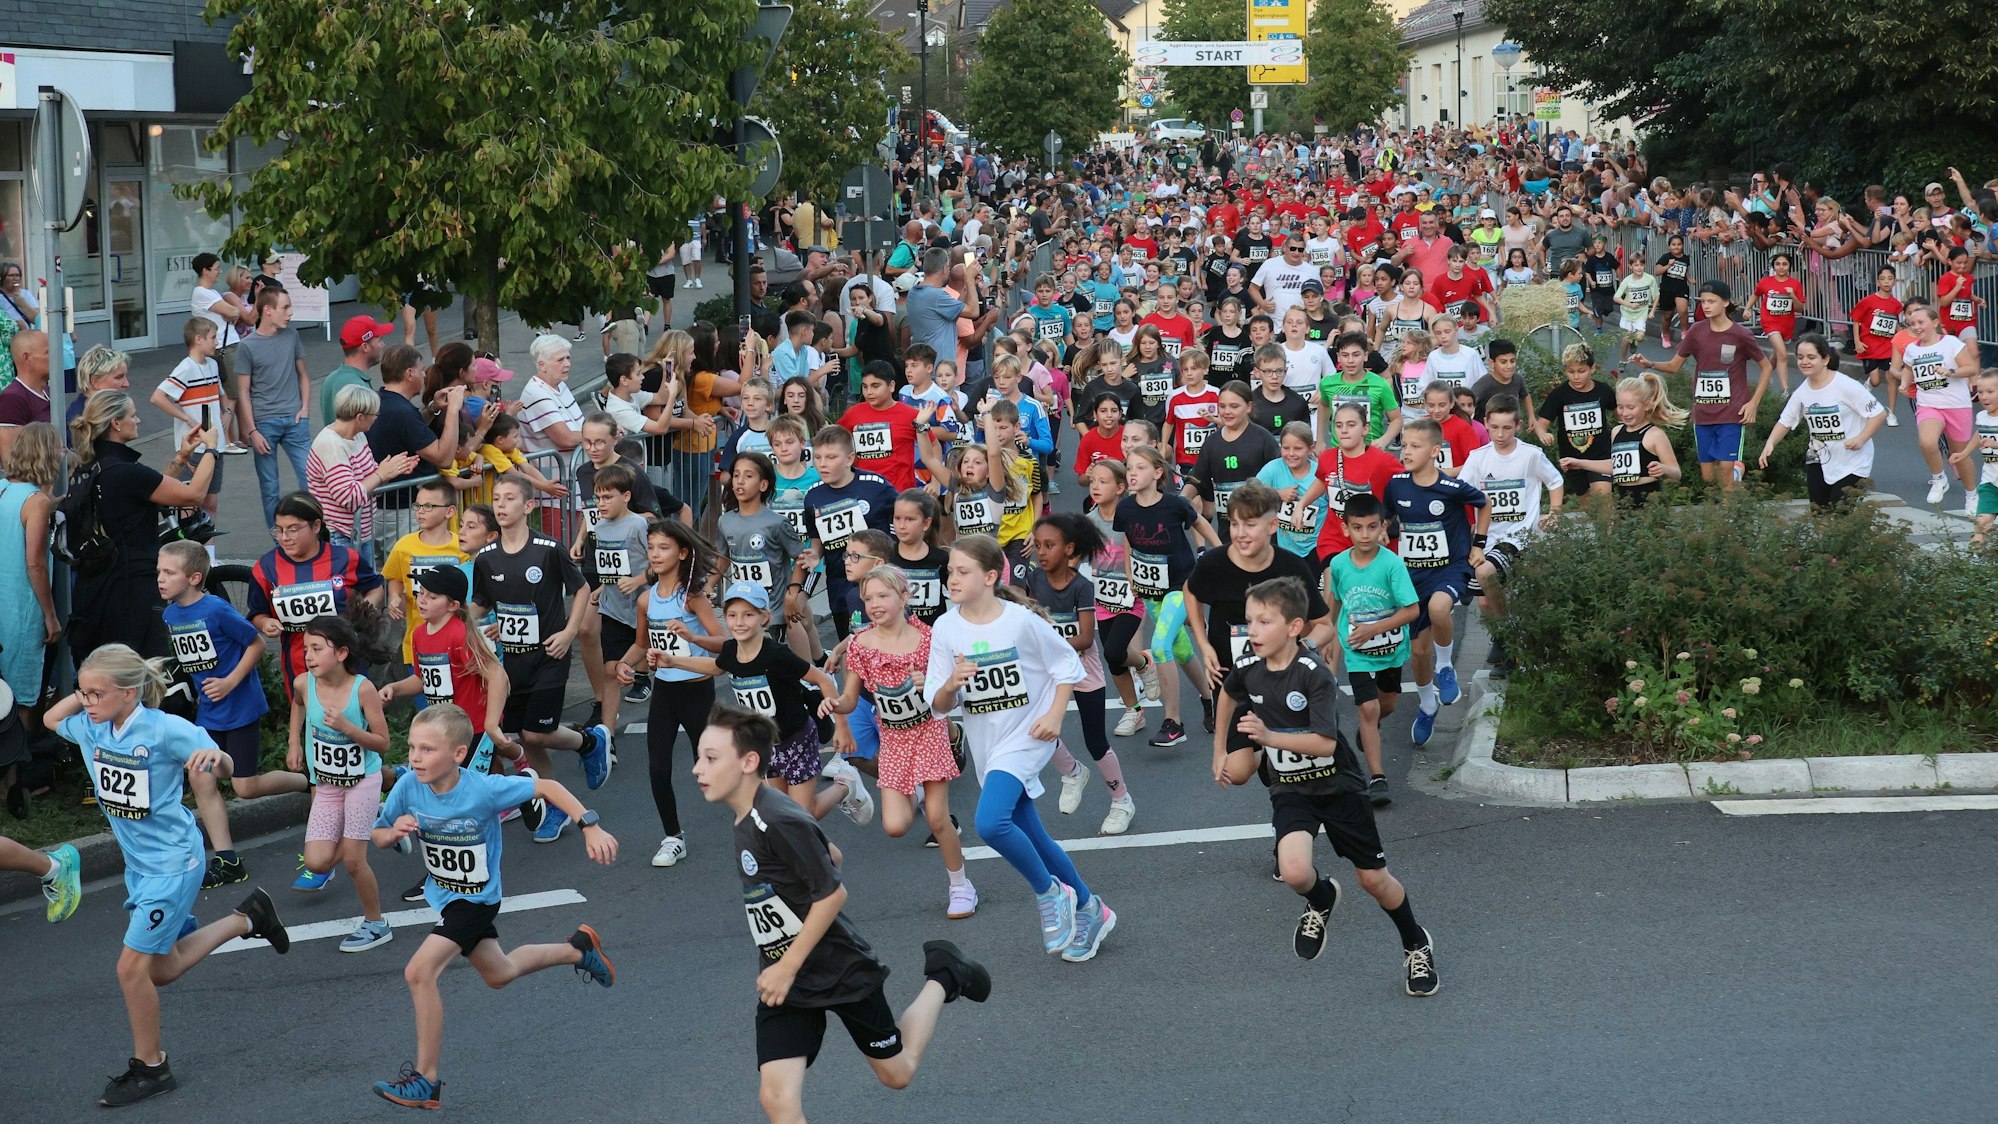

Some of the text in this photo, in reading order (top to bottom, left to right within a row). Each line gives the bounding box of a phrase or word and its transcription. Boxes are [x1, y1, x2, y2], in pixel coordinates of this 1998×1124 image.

[1196, 50, 1242, 61] START
[1671, 266, 1684, 274] 233
[1771, 300, 1788, 308] 439
[1310, 328, 1320, 338] 36
[1876, 318, 1894, 330] 438
[1146, 380, 1168, 392] 830
[1700, 378, 1724, 392] 156
[1274, 416, 1282, 428] 5
[1570, 411, 1596, 426] 198
[1808, 415, 1840, 428] 1658
[858, 432, 884, 446] 464
[1224, 456, 1238, 470] 18
[1487, 490, 1520, 508] 588
[960, 502, 985, 520] 639
[822, 510, 854, 534] 737
[1406, 534, 1438, 552] 743
[599, 552, 622, 568] 646
[1132, 561, 1160, 580] 238
[1098, 580, 1128, 598] 234
[276, 594, 332, 617] 1682
[498, 616, 529, 636] 732
[174, 633, 210, 656] 1603
[650, 632, 680, 651] 652
[964, 664, 1020, 693] 1505
[738, 690, 772, 710] 610
[314, 742, 362, 768] 1593
[100, 766, 136, 796] 622
[424, 832, 480, 842] Bergneustädter
[426, 846, 476, 873] 580
[148, 908, 165, 932] 9
[748, 903, 784, 934] 736
